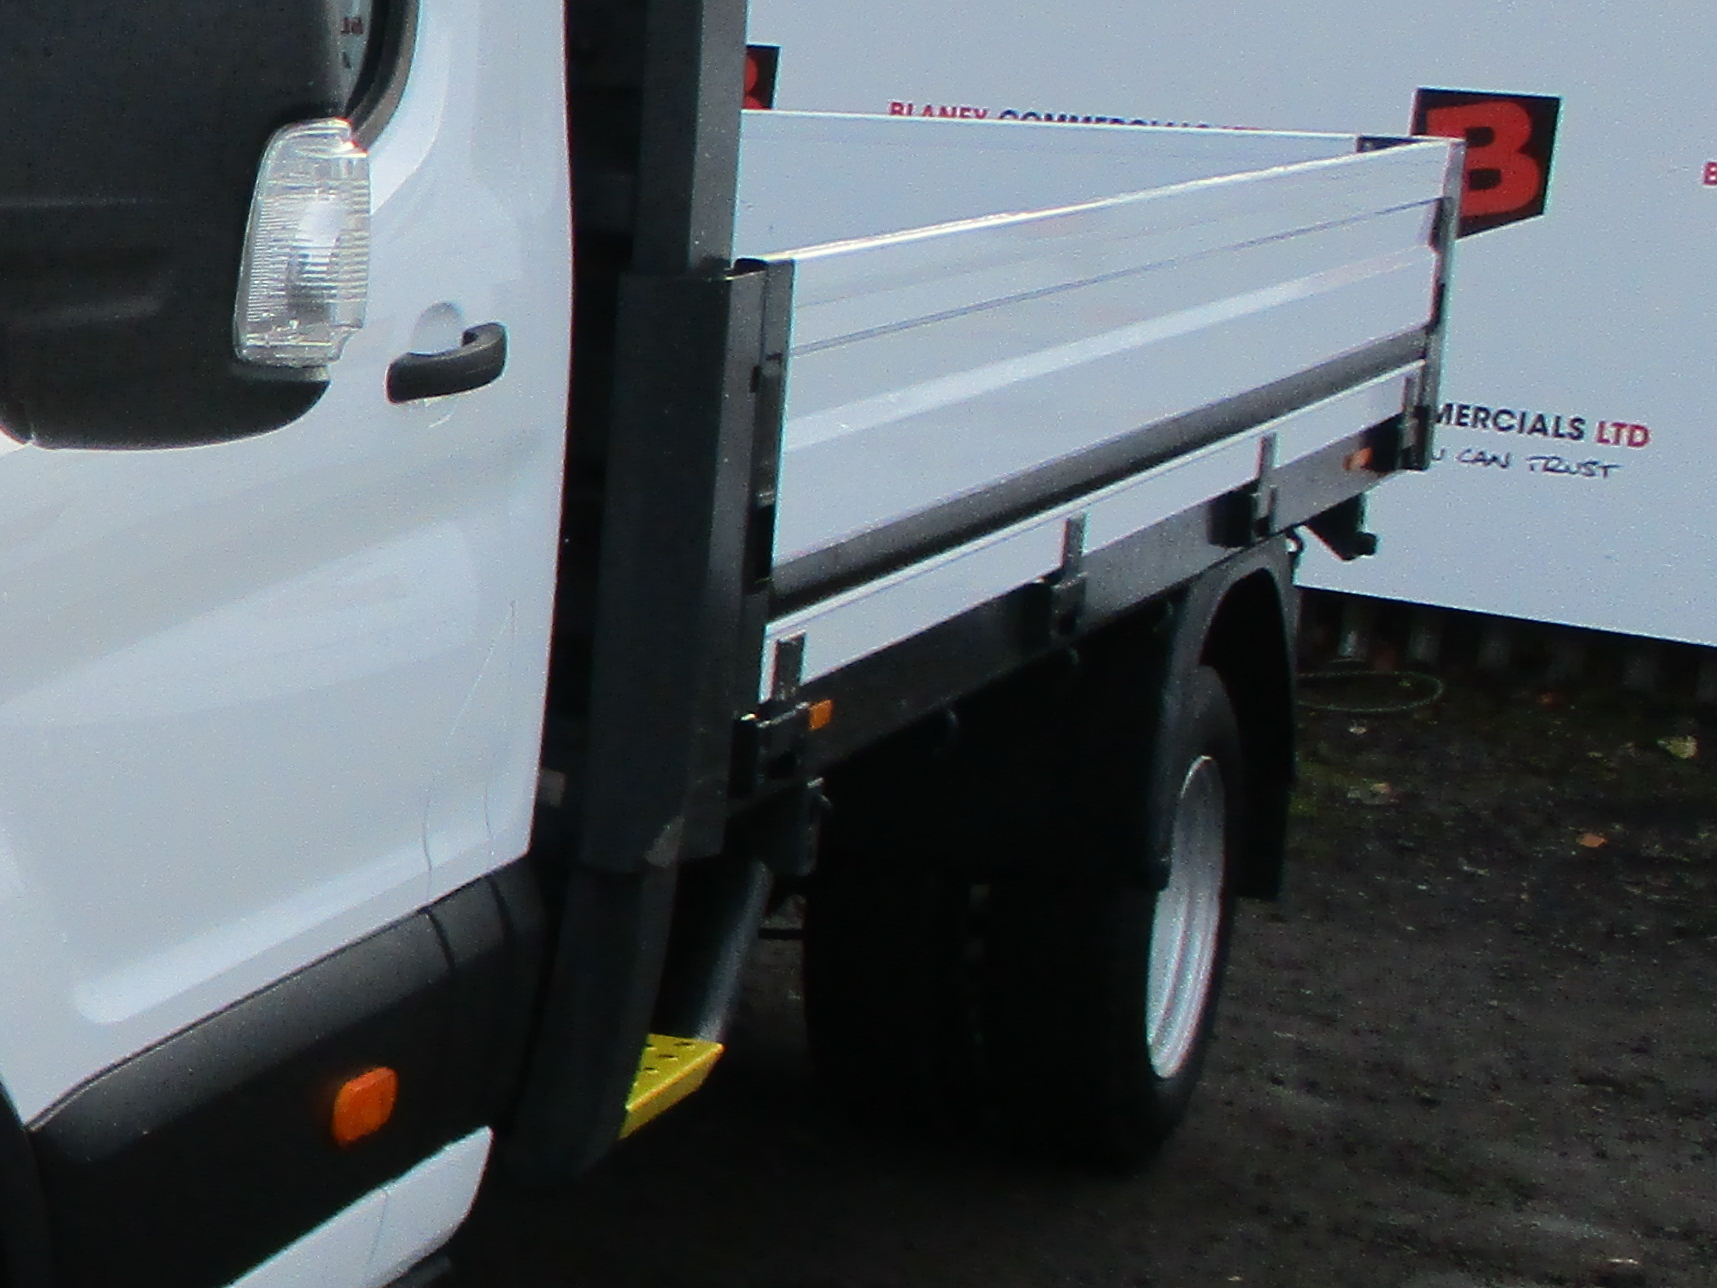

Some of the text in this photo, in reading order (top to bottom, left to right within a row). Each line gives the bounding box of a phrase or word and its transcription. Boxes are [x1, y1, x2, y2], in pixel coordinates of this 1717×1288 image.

[1595, 420, 1651, 449] LTD
[1456, 448, 1512, 470] CAN
[1525, 455, 1623, 480] TRUST
